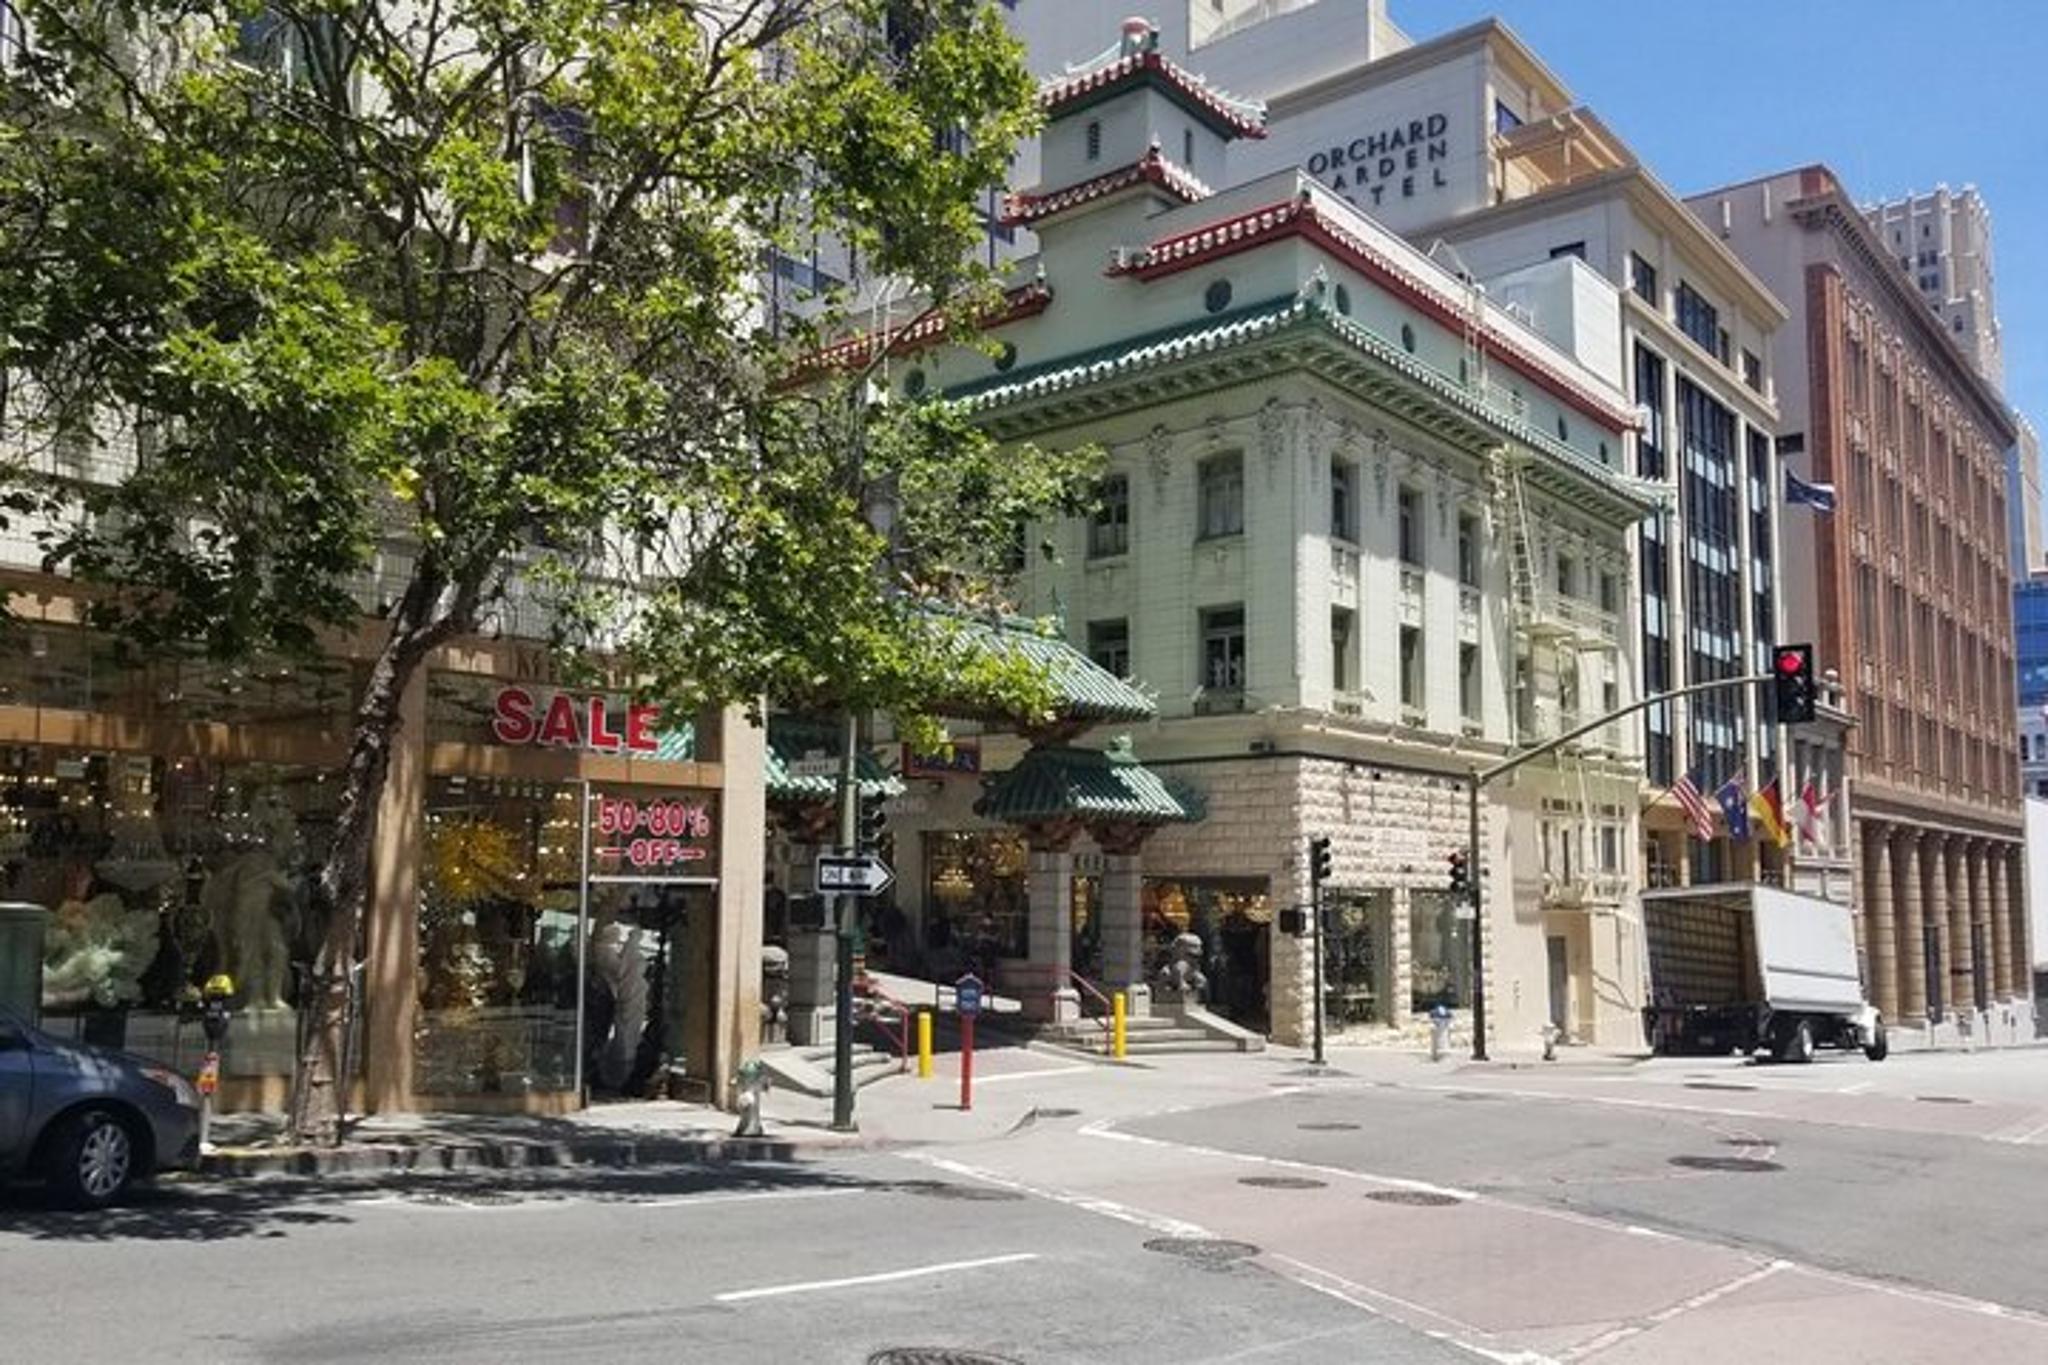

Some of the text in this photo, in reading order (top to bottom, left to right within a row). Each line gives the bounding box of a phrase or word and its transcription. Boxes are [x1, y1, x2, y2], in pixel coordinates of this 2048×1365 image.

[1308, 113, 1448, 174] ORCHARD
[1332, 140, 1447, 190] ARDEN
[492, 686, 663, 753] SALE
[630, 838, 681, 866] OFF
